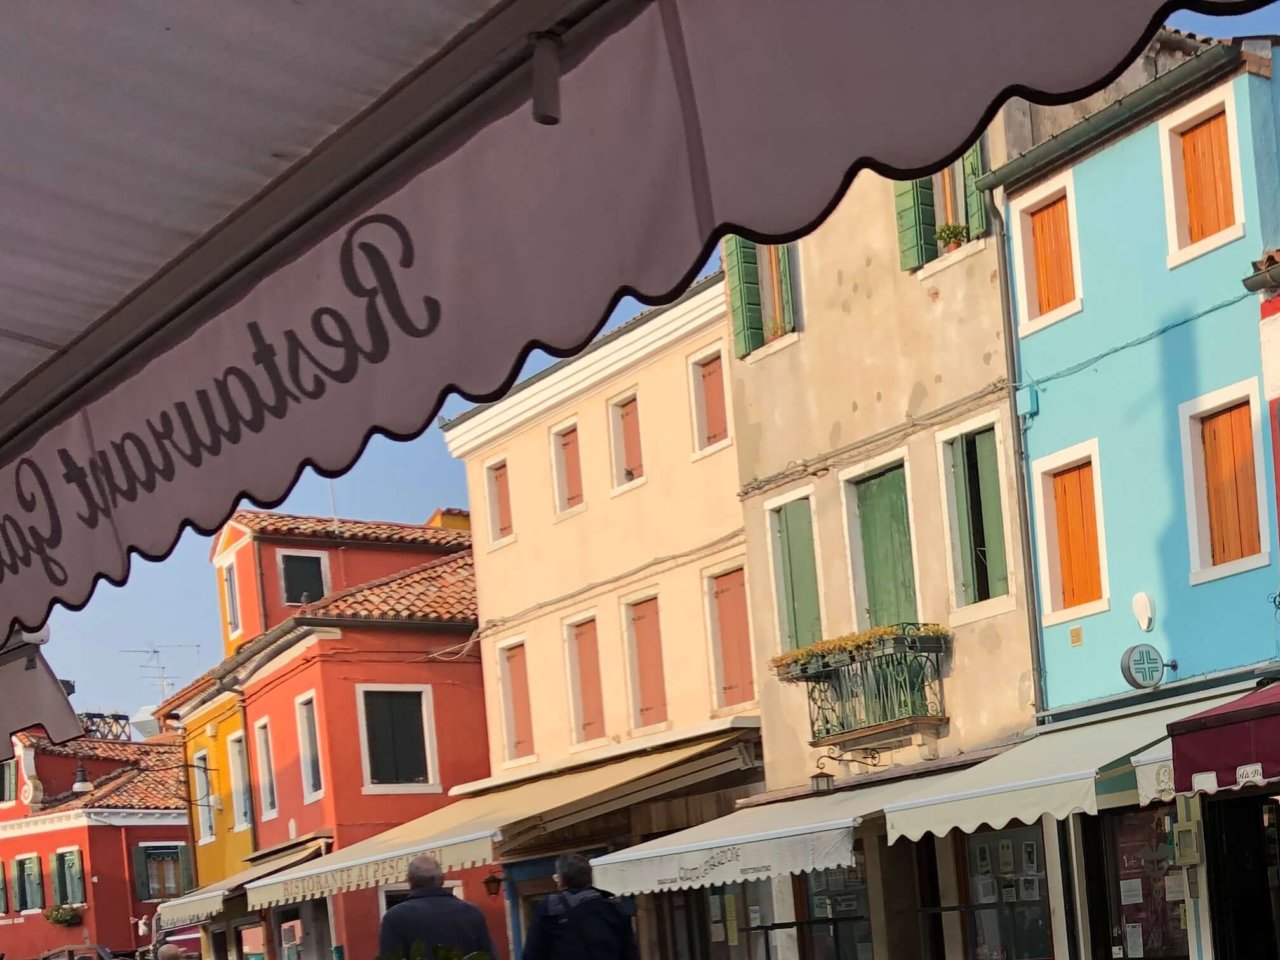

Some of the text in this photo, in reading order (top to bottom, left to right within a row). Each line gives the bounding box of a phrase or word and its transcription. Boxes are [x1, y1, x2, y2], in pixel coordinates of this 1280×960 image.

[283, 849, 443, 898] RISTORANTE AI PESCI
